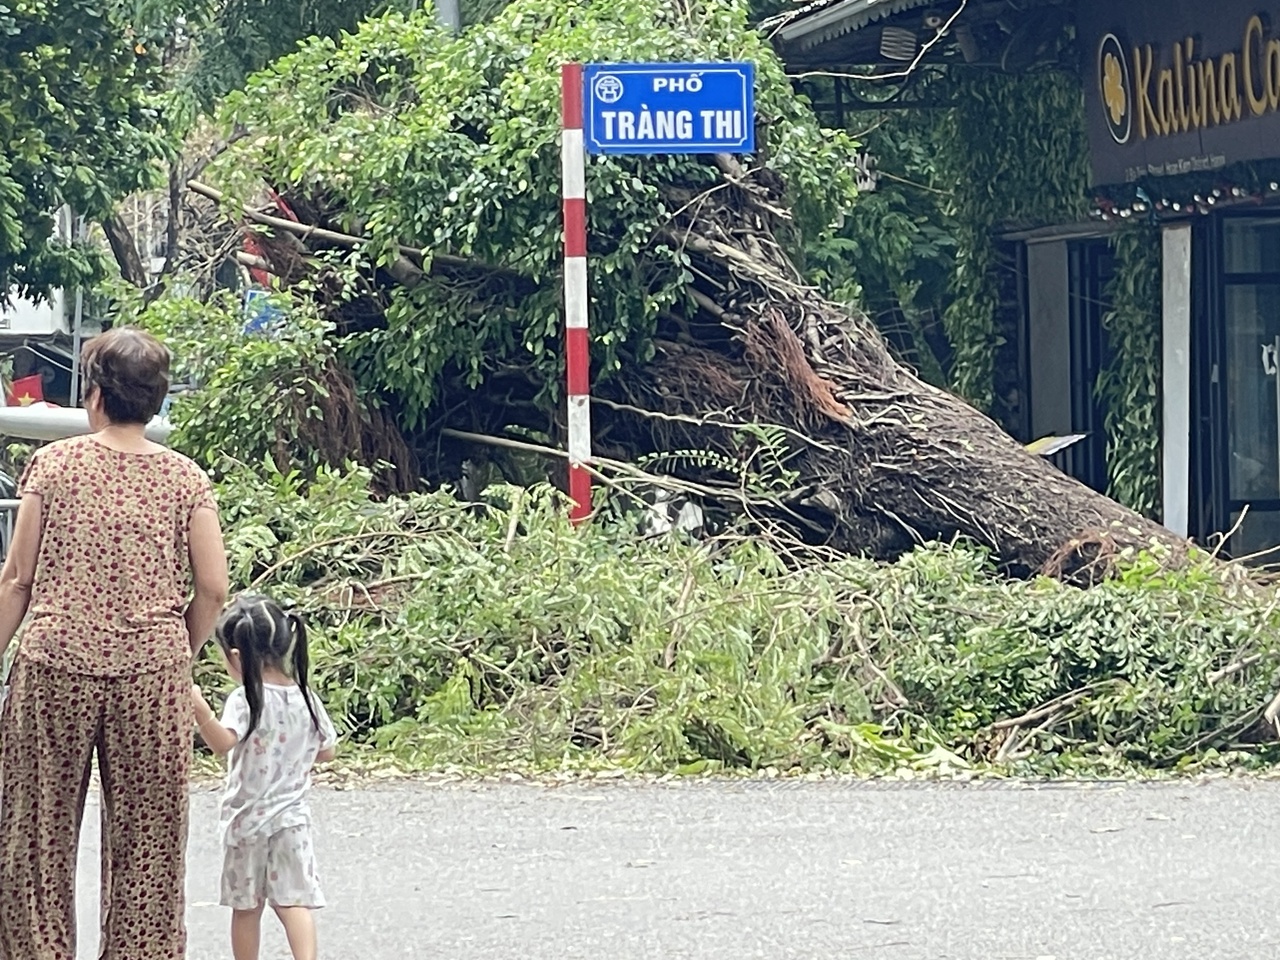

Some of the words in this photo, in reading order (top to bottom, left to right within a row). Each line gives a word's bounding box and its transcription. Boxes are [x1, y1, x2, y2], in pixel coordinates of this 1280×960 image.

[653, 72, 703, 93] PHỐ
[1135, 37, 1241, 139] Kalina
[602, 103, 693, 140] TRÀNG
[700, 110, 742, 139] THI
